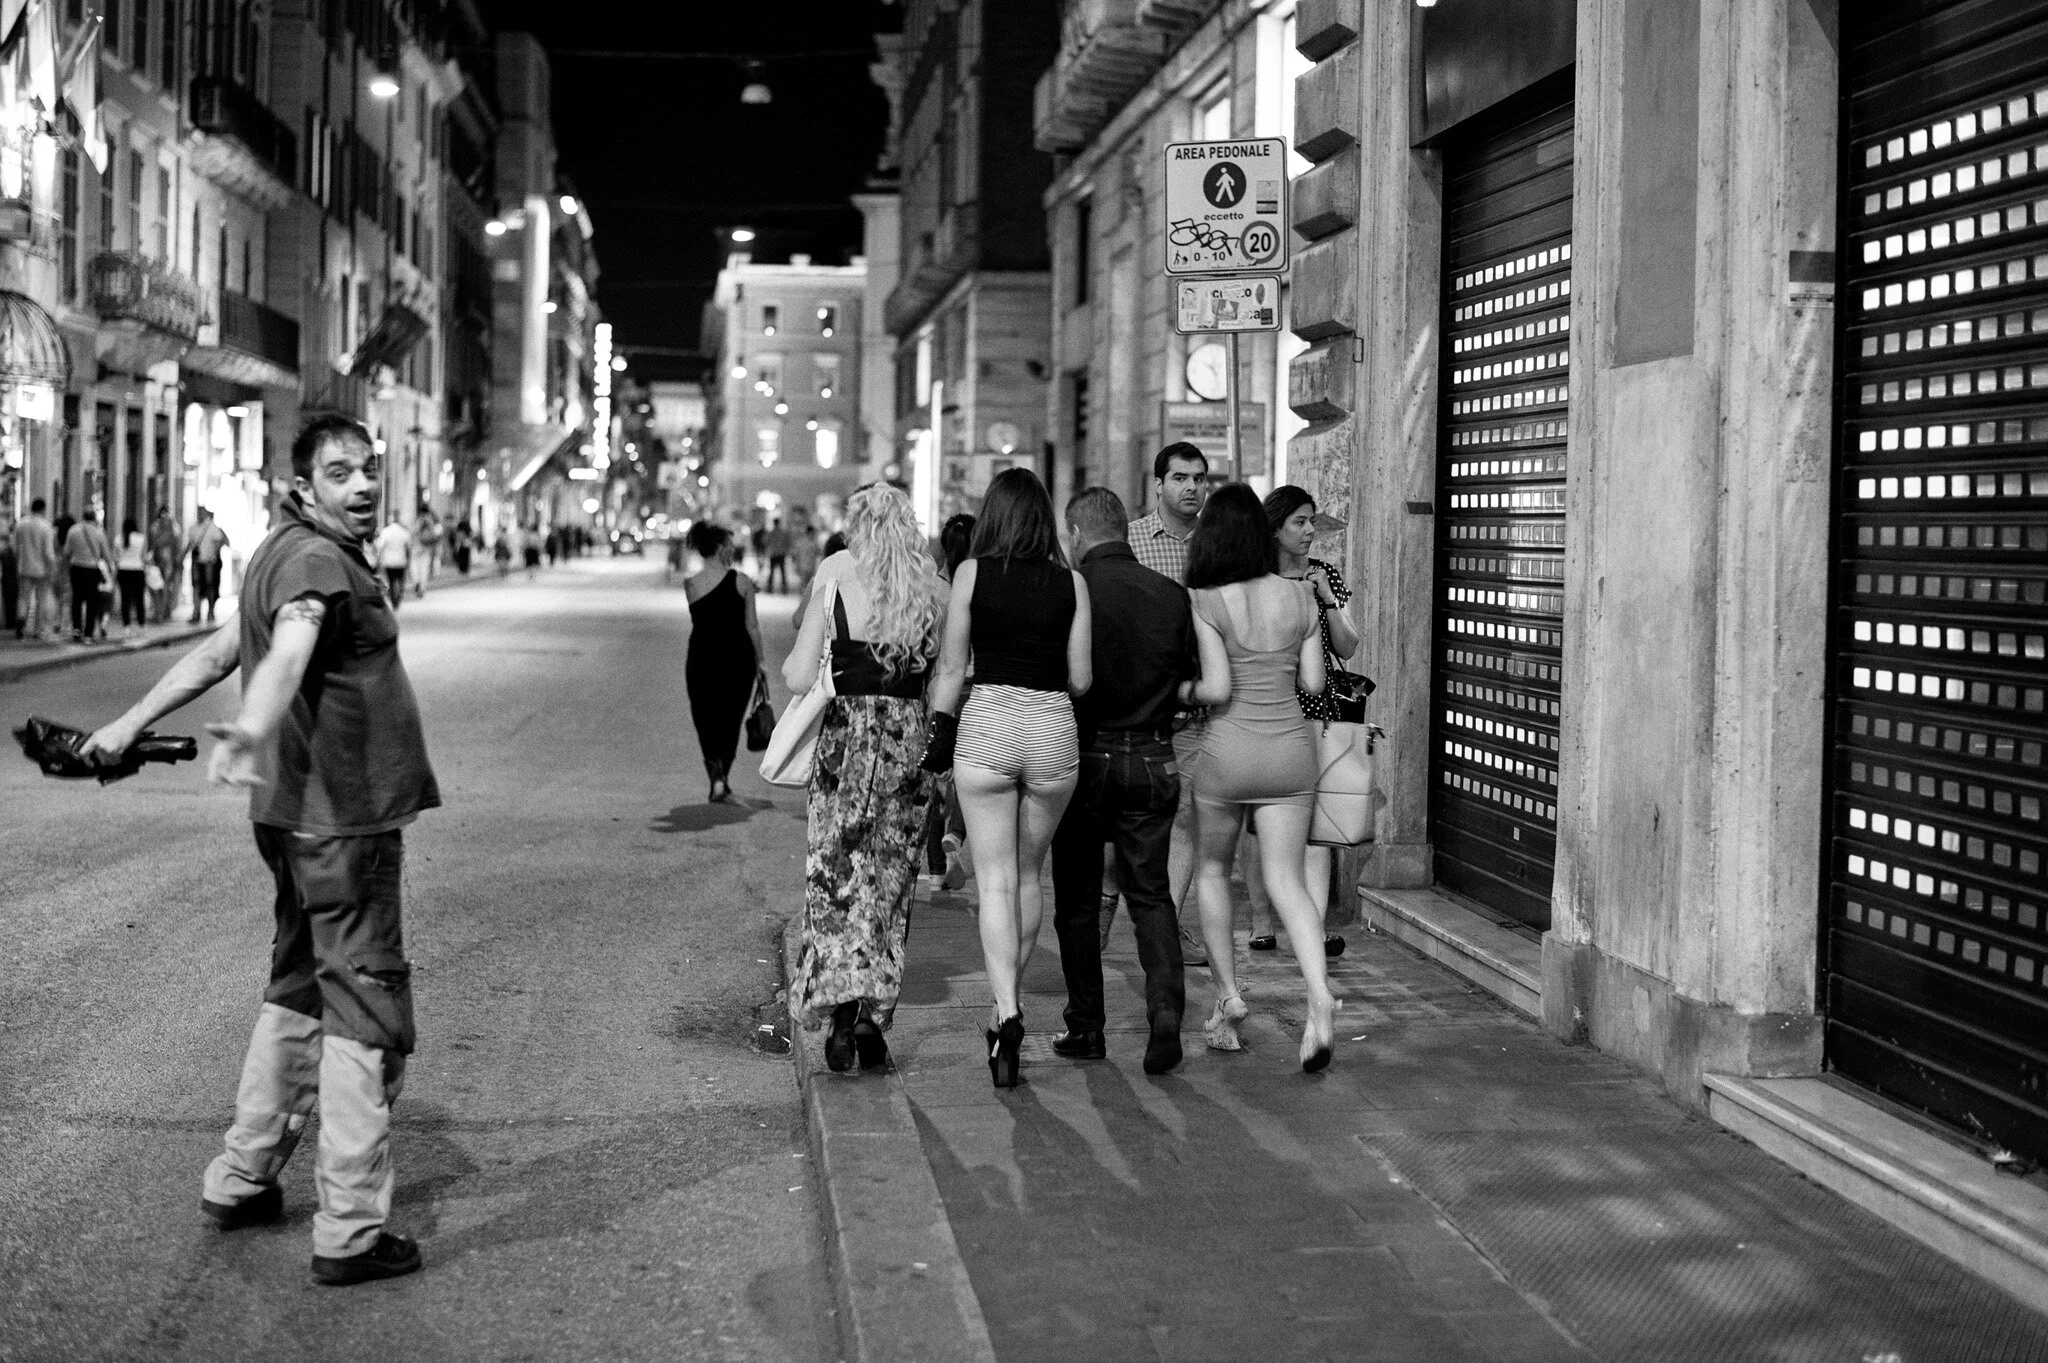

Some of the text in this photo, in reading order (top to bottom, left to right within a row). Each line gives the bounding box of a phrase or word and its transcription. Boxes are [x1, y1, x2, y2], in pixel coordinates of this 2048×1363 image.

[1175, 144, 1270, 160] AREA PEDONALE
[1204, 212, 1244, 221] eccetto
[1249, 232, 1271, 253] 20
[1212, 251, 1226, 261] 10
